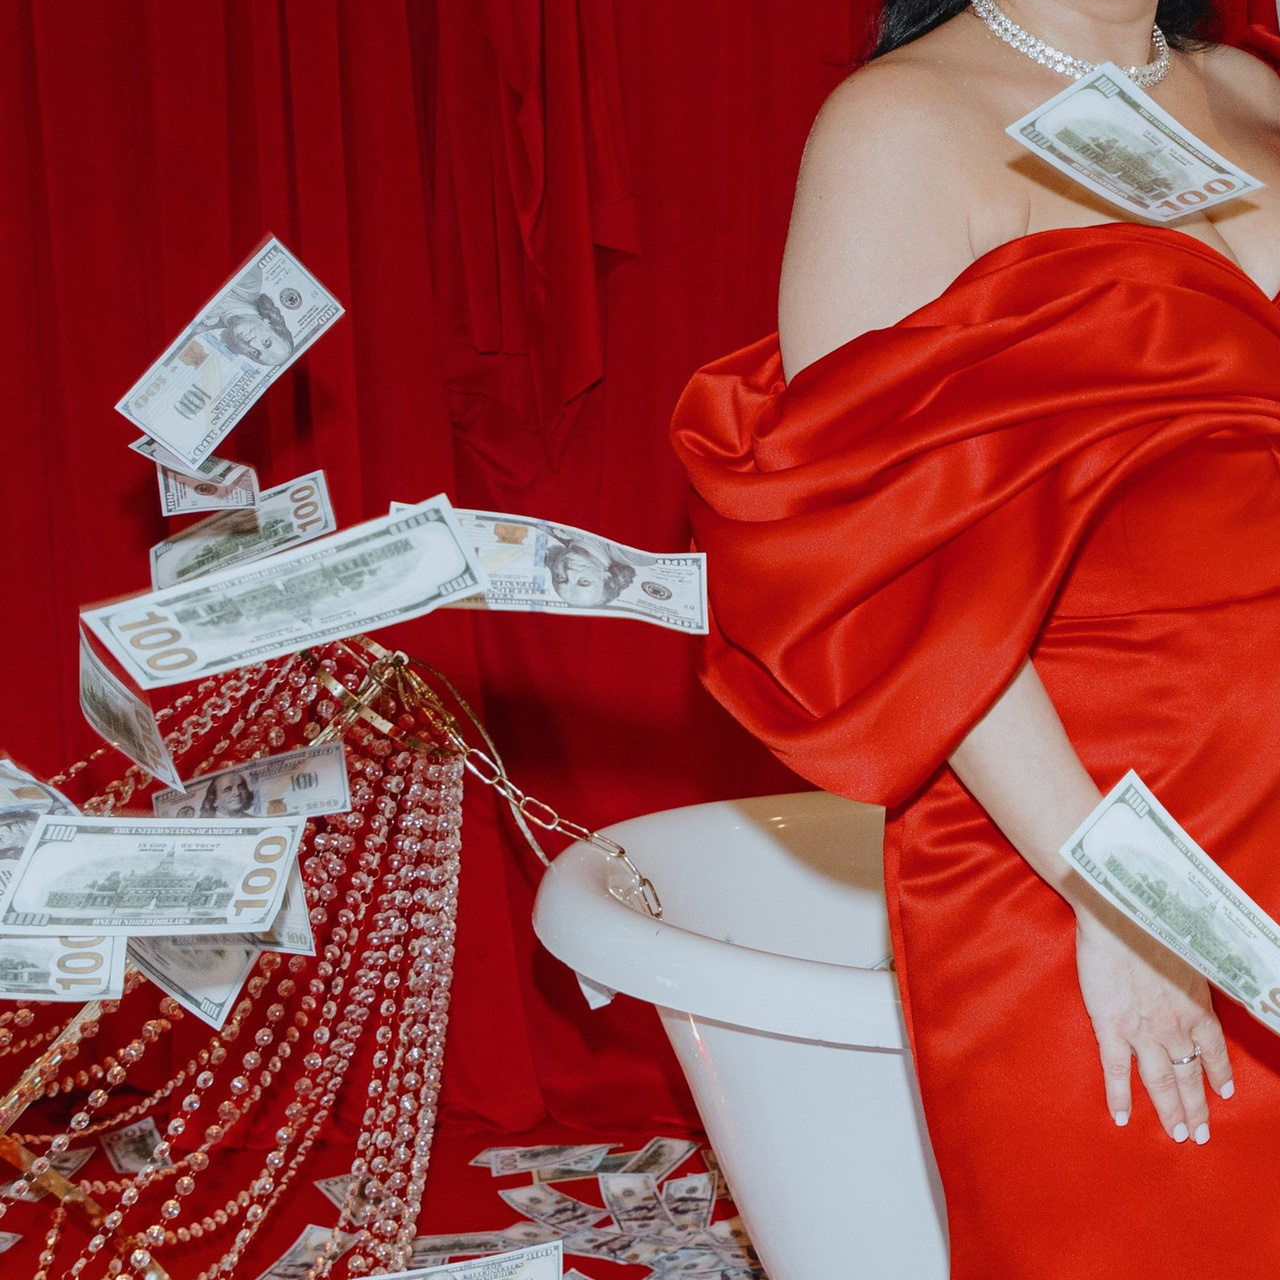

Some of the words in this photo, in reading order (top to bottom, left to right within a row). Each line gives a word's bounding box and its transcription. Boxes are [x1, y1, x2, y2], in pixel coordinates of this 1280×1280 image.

[1155, 178, 1236, 212] 100
[118, 612, 198, 672] 100
[1124, 787, 1150, 818] 100
[46, 826, 77, 841] 100
[233, 835, 288, 917] 100
[526, 1248, 556, 1262] 100
